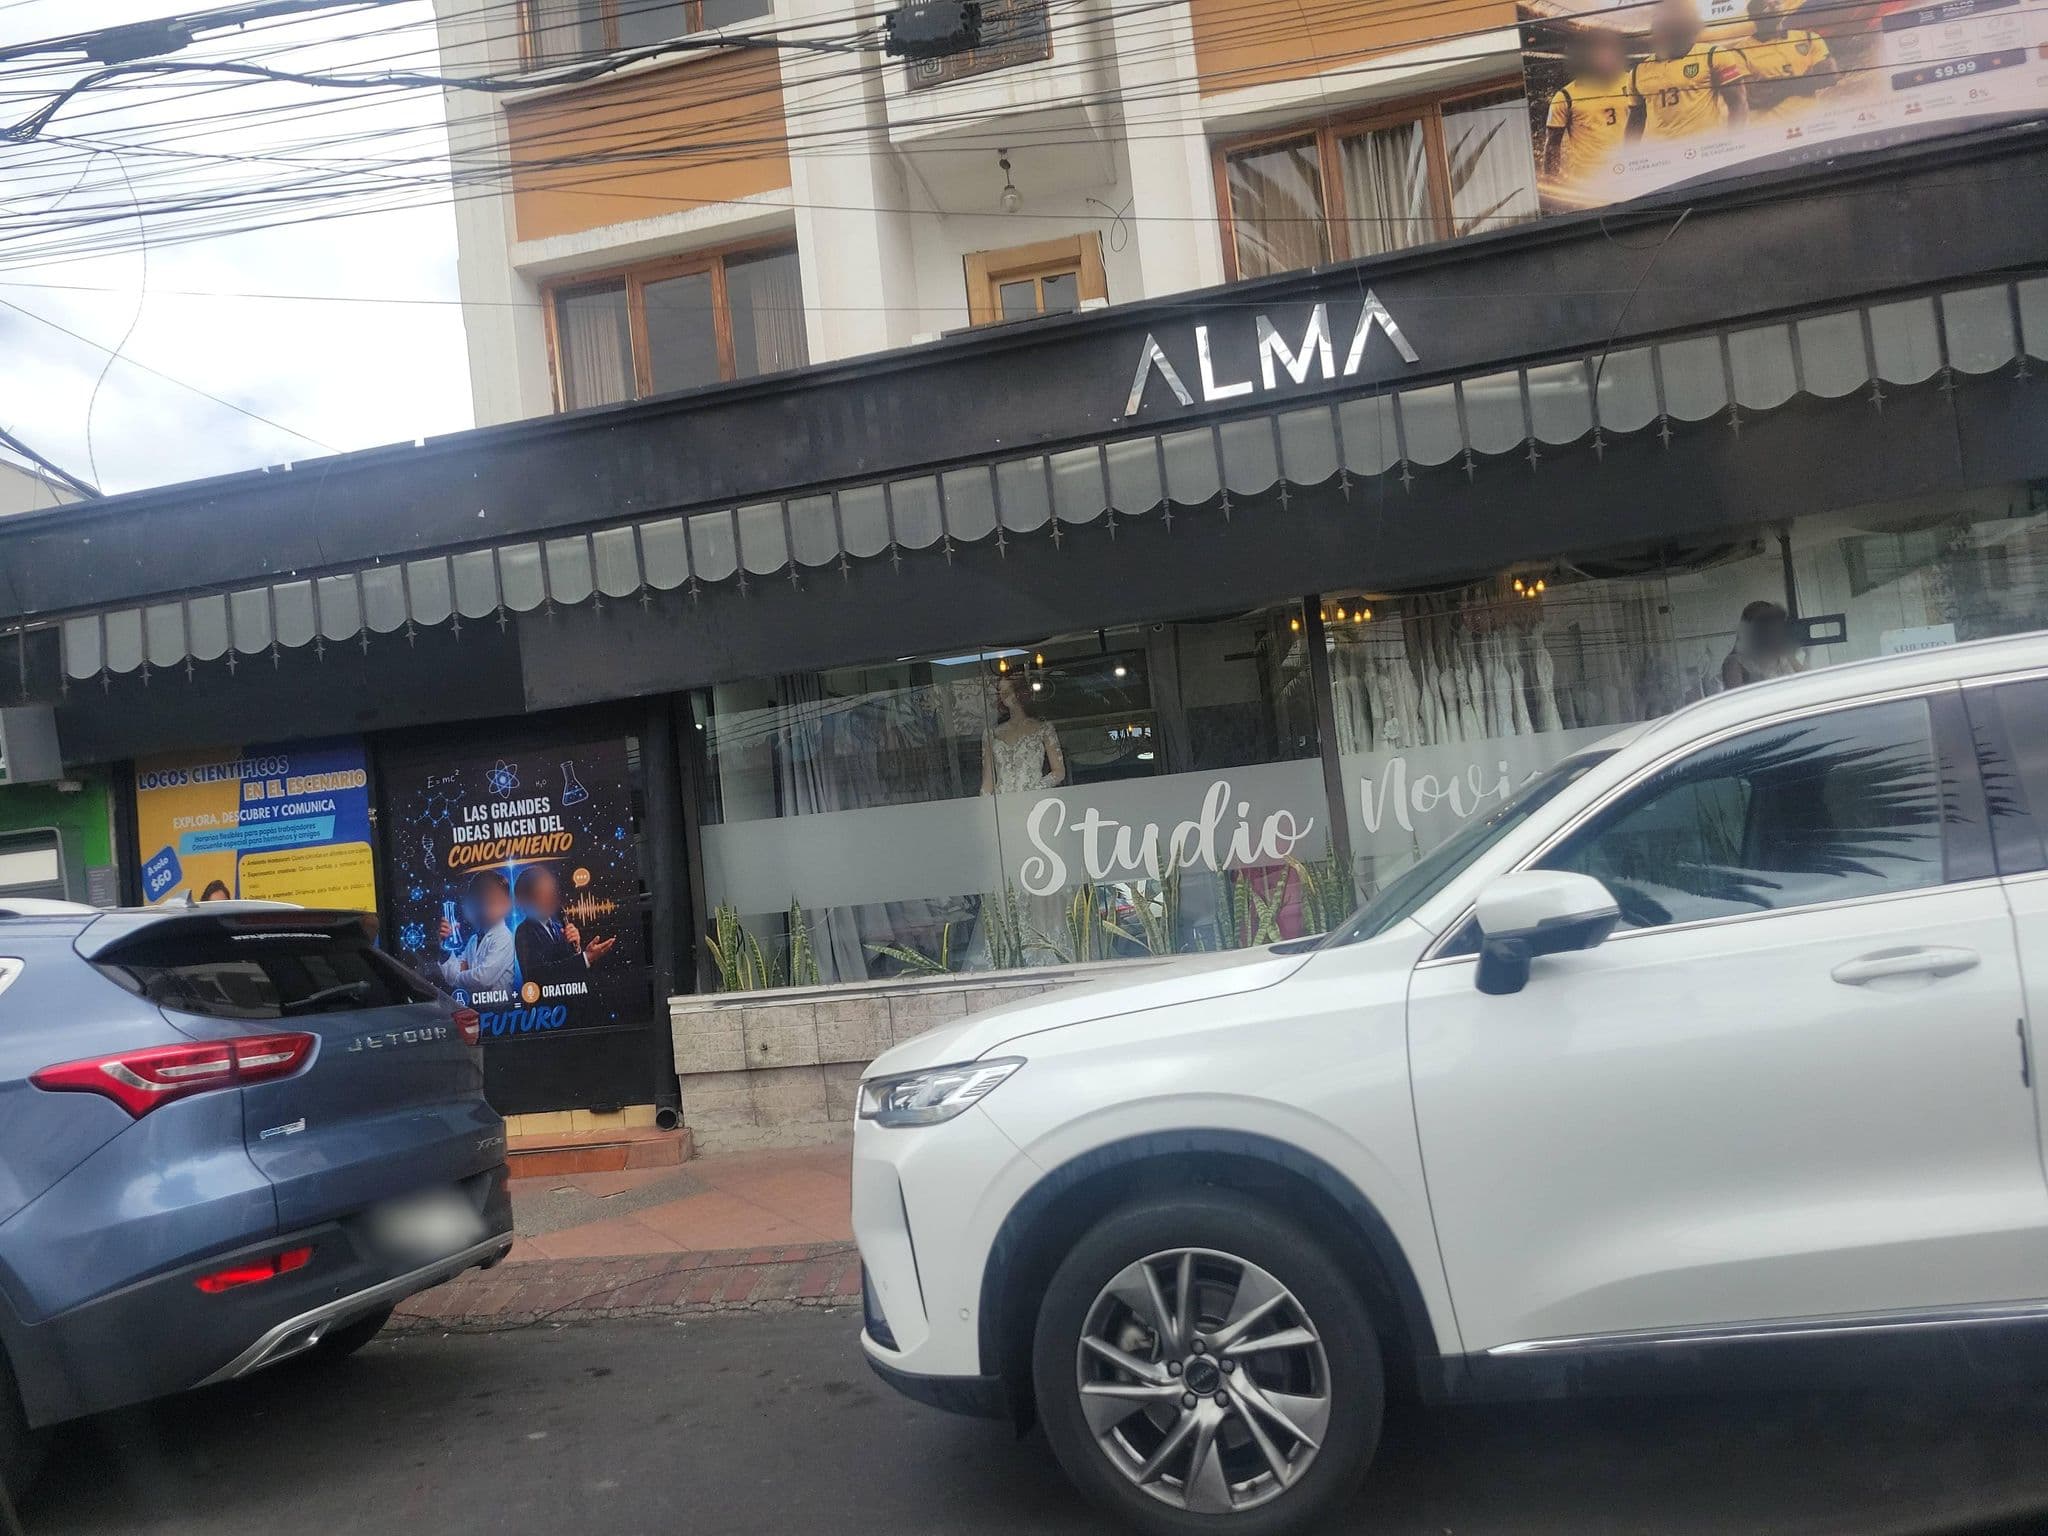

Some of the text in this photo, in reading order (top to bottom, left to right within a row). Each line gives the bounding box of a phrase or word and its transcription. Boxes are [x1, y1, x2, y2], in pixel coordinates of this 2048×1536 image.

[1711, 4, 1734, 14] FIFA
[1934, 61, 1977, 79] $9.99
[1658, 86, 1681, 108] 13
[1604, 107, 1617, 126] 3
[1124, 288, 1420, 417] ALMA
[137, 769, 189, 791] LOCOS
[243, 768, 367, 801] EN EL ESCENARIO
[222, 806, 271, 824] DESCUBRE
[272, 805, 280, 818] Y
[281, 798, 336, 816] COMUNICA
[463, 796, 551, 823] LAS GRANDES
[278, 822, 316, 834] trabajadores
[452, 814, 565, 844] IDEAS NACEN DEL
[1020, 757, 1544, 899] Studio Novi
[447, 832, 574, 868] CONOCIMIENTO
[151, 869, 172, 892] $60
[472, 989, 509, 1005] CIENCIA
[542, 981, 588, 998] ORATORIA
[479, 1004, 568, 1037] FUTURO
[347, 1026, 448, 1052] JETOUR
